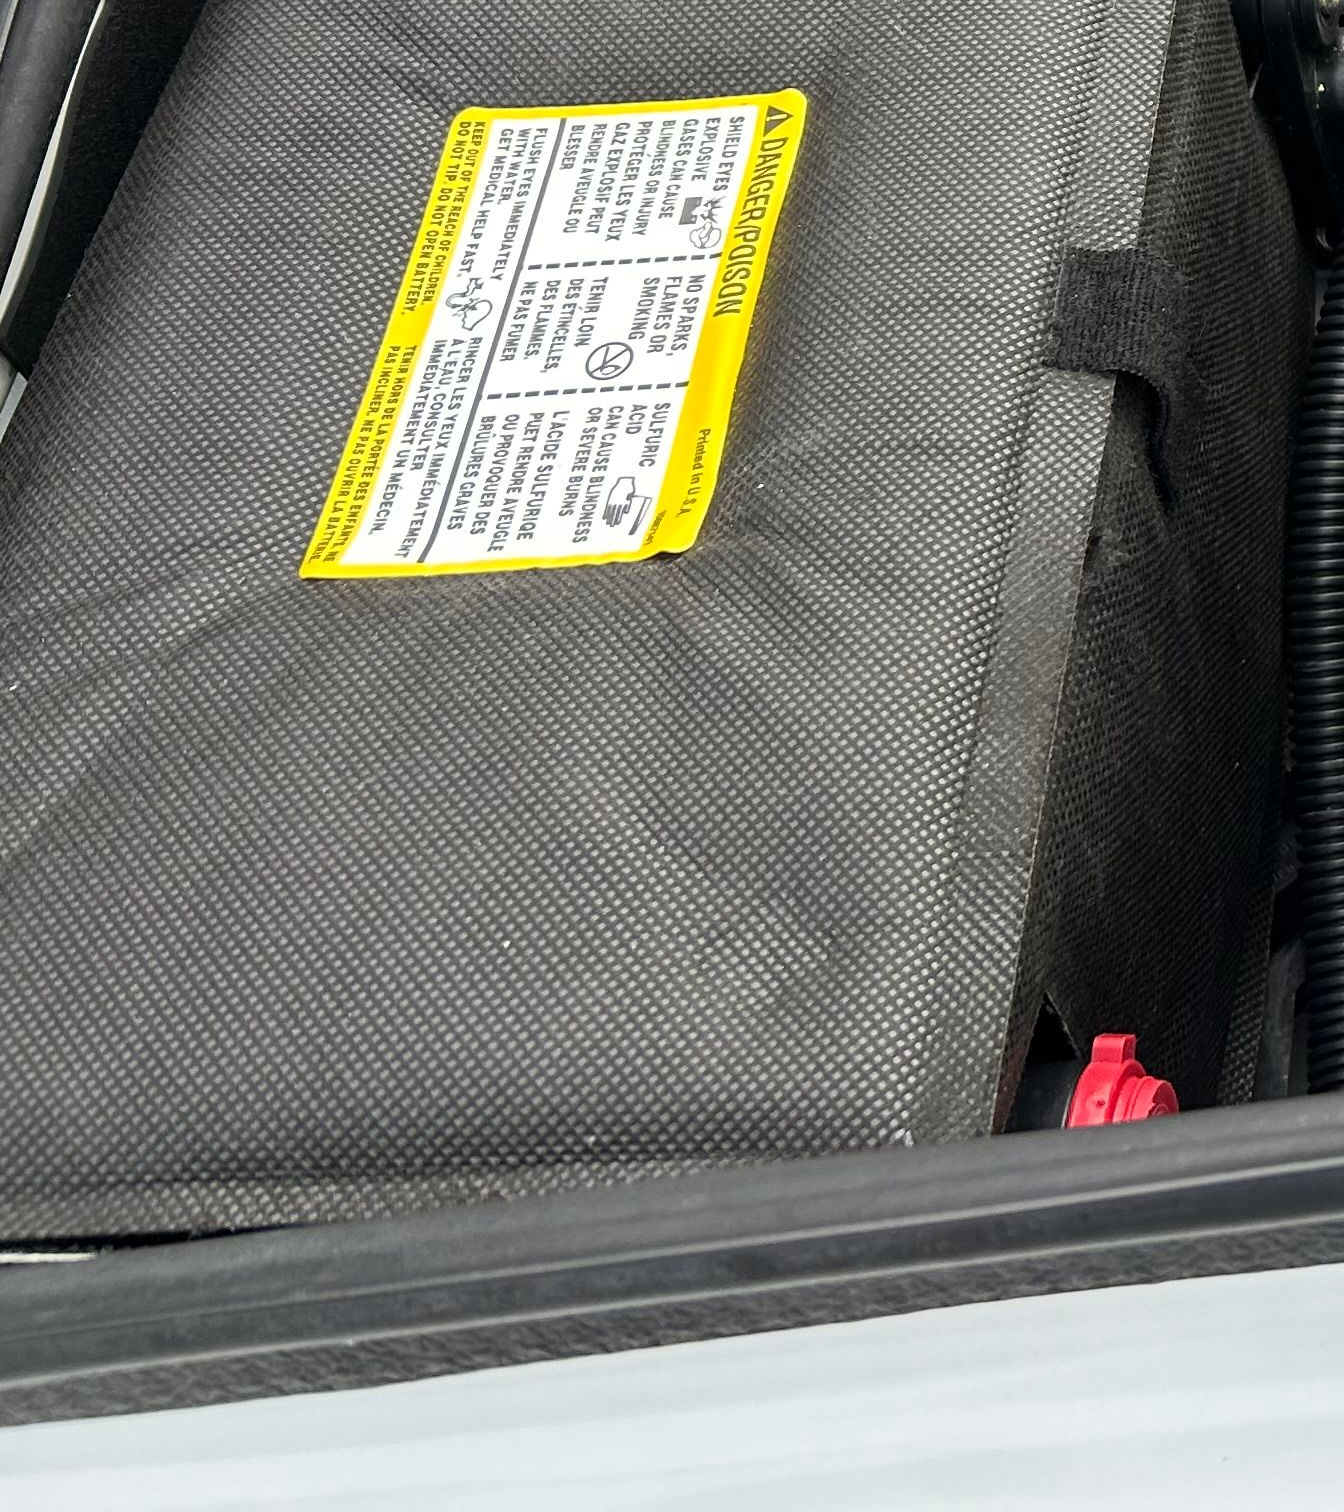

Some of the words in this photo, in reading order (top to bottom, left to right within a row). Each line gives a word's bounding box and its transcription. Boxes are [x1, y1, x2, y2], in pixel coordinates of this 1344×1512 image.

[456, 120, 472, 137] DO
[470, 120, 485, 146] KEEP
[497, 127, 514, 151] GET
[511, 127, 531, 157] WITH
[582, 123, 607, 164] RENDRE
[610, 121, 631, 145] GAZ
[675, 118, 699, 156] GASES
[721, 115, 745, 158] SHIELD
[449, 139, 467, 160] NOT
[463, 148, 479, 167] OUT
[526, 127, 548, 164] FLUSH
[559, 124, 585, 170] BLESSER
[622, 120, 653, 181] PROTÉGER
[647, 119, 676, 176] BLINDNESS
[690, 116, 721, 181] EXPLOSIVE
[459, 169, 473, 182] OF
[479, 155, 507, 206] MEDICAL
[497, 160, 521, 204] WATER.
[515, 167, 536, 197] EYES
[594, 148, 623, 203] EXPLOSIF
[668, 159, 688, 181] CAN
[712, 161, 734, 191] EYES
[436, 187, 453, 201] DO
[452, 184, 469, 203] THE
[567, 167, 594, 215] AVEUGLE
[614, 184, 635, 206] LES
[643, 179, 660, 194] OR
[657, 183, 681, 219] CAUSE
[429, 204, 447, 226] NOT
[442, 205, 462, 237] REACH
[470, 209, 490, 240] HELP
[562, 217, 580, 233] OU
[584, 206, 606, 234] PEUT
[604, 209, 628, 241] YEUX
[631, 196, 654, 235] INJURY
[713, 137, 787, 316] DANGER/POISON
[419, 229, 439, 258] OPEN
[437, 239, 451, 252] OF
[490, 200, 525, 280] IMMEDIATELY
[457, 242, 479, 276] FAST.
[401, 262, 429, 314] BATTERY.
[421, 254, 446, 304] CHILDREN.
[519, 280, 538, 296] NE
[541, 279, 561, 301] DES
[564, 277, 584, 299] DES
[583, 276, 608, 313] TENIR
[685, 273, 706, 293] NO
[512, 298, 533, 320] PAS
[627, 276, 660, 340] SMOKING
[653, 275, 683, 330] FLAMES
[540, 302, 582, 373] ÉTINCELLES,
[573, 316, 596, 347] LOIN
[666, 296, 699, 356] SPARKS,
[383, 345, 401, 364] PAS
[499, 323, 525, 362] FUMER
[646, 334, 667, 353] OR
[396, 344, 417, 374] TENIR
[434, 349, 461, 389] L'EAU,
[456, 336, 483, 383] RINCER
[386, 376, 405, 404] HORS
[401, 339, 446, 444] IMMÉDIATEMENT
[447, 386, 466, 410] LES
[359, 419, 375, 432] NE
[375, 422, 390, 436] LA
[380, 406, 396, 420] DE
[501, 413, 520, 430] OU
[522, 411, 544, 442] PUET
[585, 406, 603, 423] OR
[603, 405, 624, 429] CAN
[624, 403, 647, 435] ACID
[351, 435, 369, 455] PAS
[409, 392, 446, 470] CONSULTER
[434, 413, 458, 449] YEUX
[463, 415, 496, 478] BRÛLURES
[539, 410, 569, 460] L'ACIDE
[638, 402, 671, 467] SULFURIC
[360, 438, 385, 478] PORTÉE
[392, 449, 410, 468] UN
[570, 426, 598, 472] SEVERE
[591, 432, 616, 472] CAUSE
[691, 427, 711, 470] Printed
[337, 457, 361, 497] OUVRIR
[478, 433, 514, 507] PROVOQUER
[505, 445, 534, 494] RENDRE
[689, 471, 703, 485] in
[331, 499, 346, 513] LA
[352, 480, 370, 501] DES
[368, 472, 403, 534] MÉDECIN.
[395, 453, 444, 557] IMMÉDIATEMENT
[446, 481, 475, 530] GRAVES
[516, 464, 553, 540] SULFURIQE
[557, 475, 583, 516] BURNS
[676, 485, 701, 517] U.S.A.
[469, 511, 490, 535] DES
[486, 497, 518, 552] AVEUGLE
[571, 475, 604, 543] BLINDNESS
